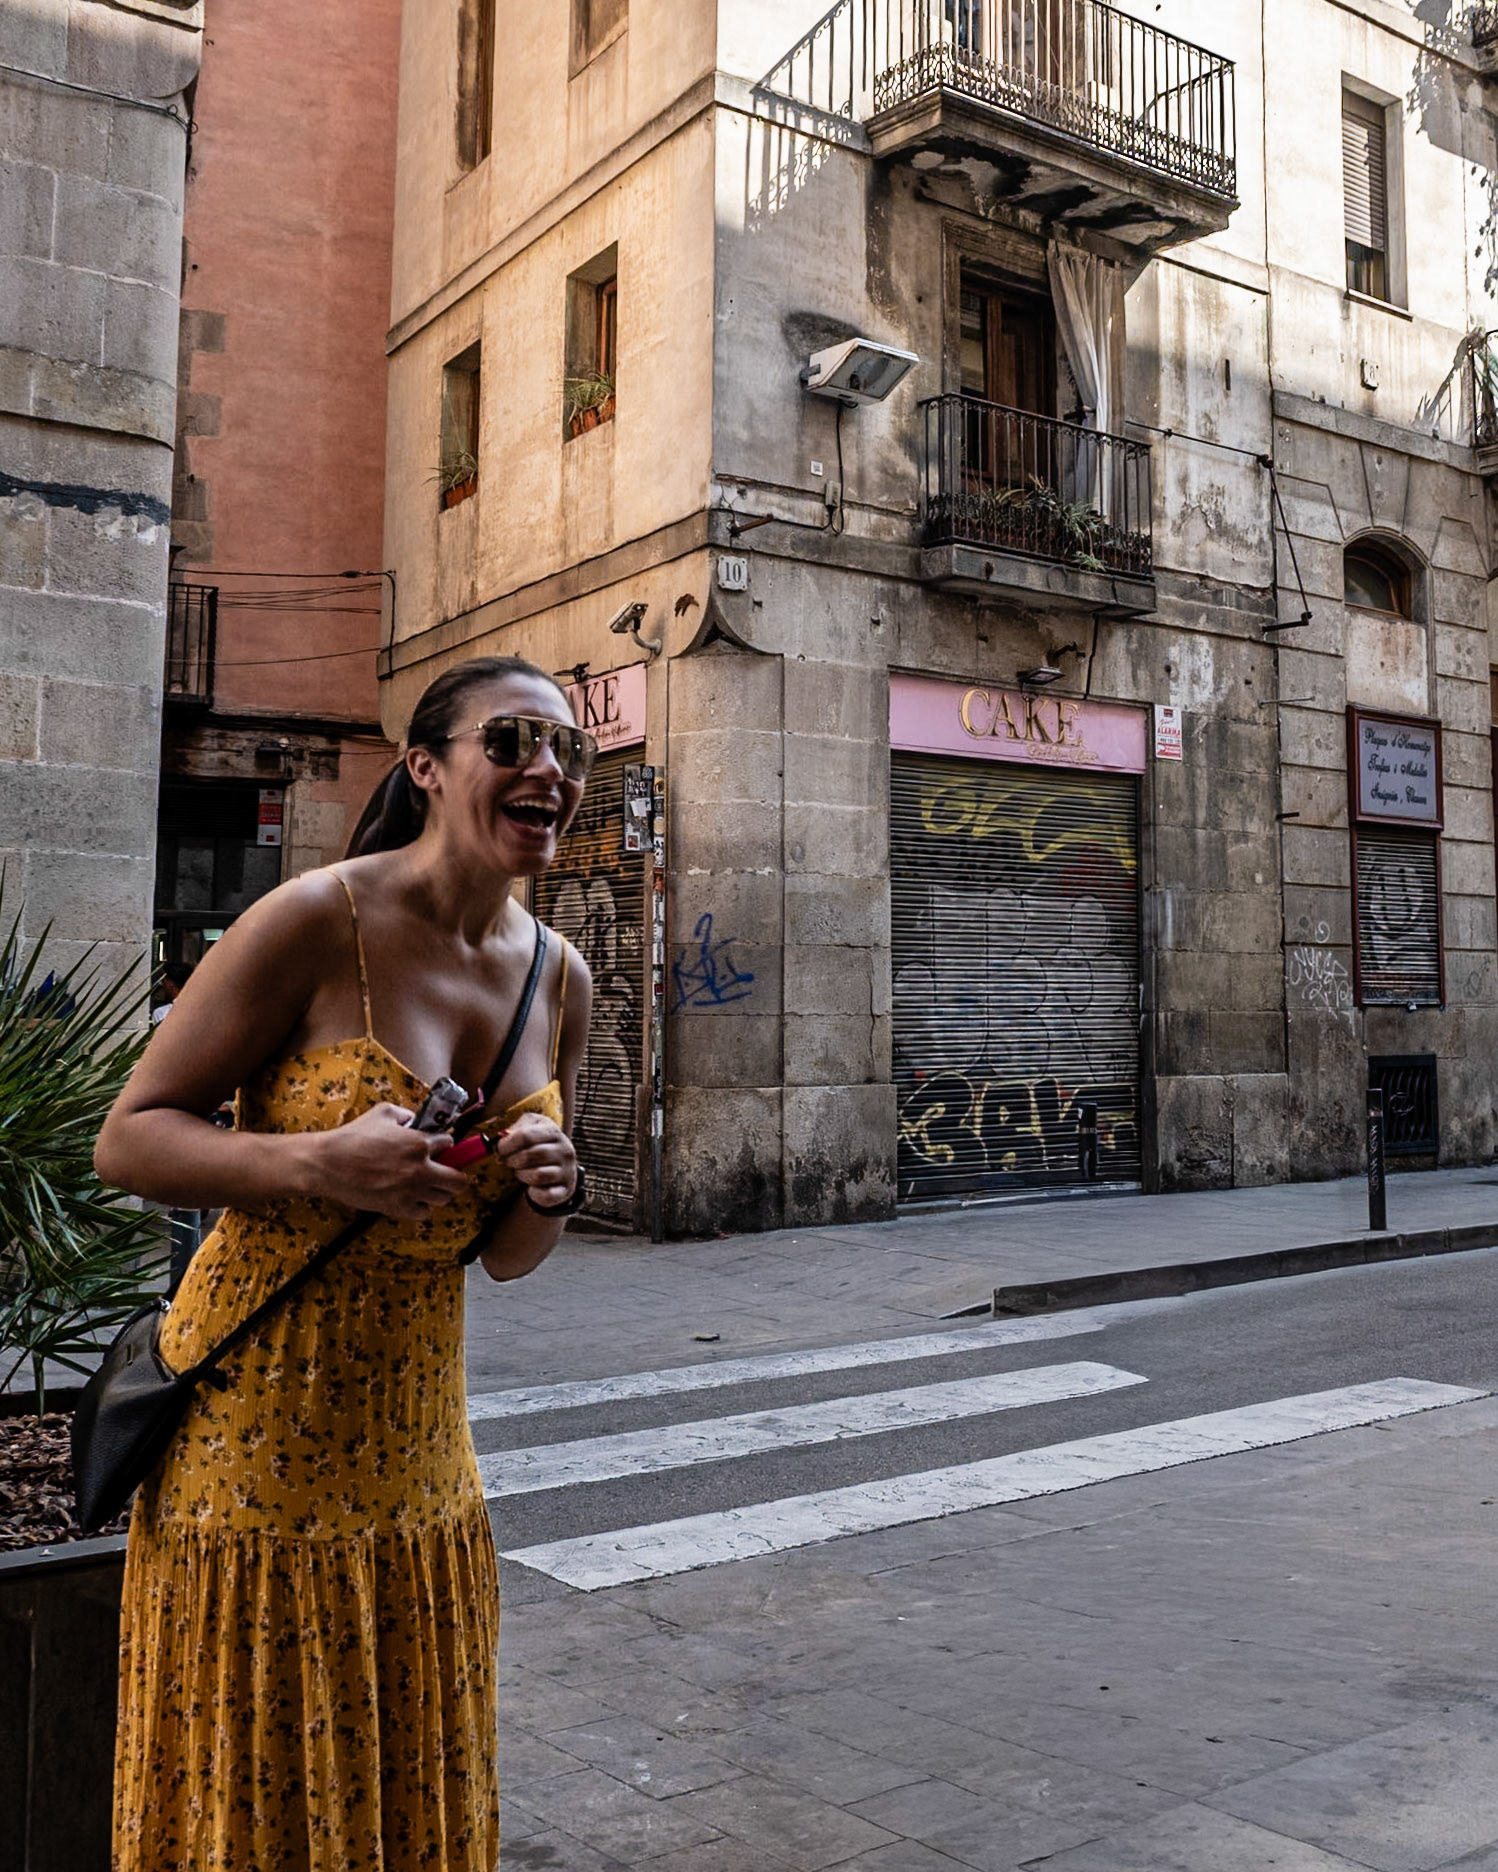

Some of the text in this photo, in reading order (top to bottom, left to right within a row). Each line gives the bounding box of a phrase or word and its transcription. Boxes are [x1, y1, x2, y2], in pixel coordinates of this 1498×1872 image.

[725, 562, 742, 582] 10
[570, 676, 620, 730] KE
[960, 687, 1084, 747] CAKE
